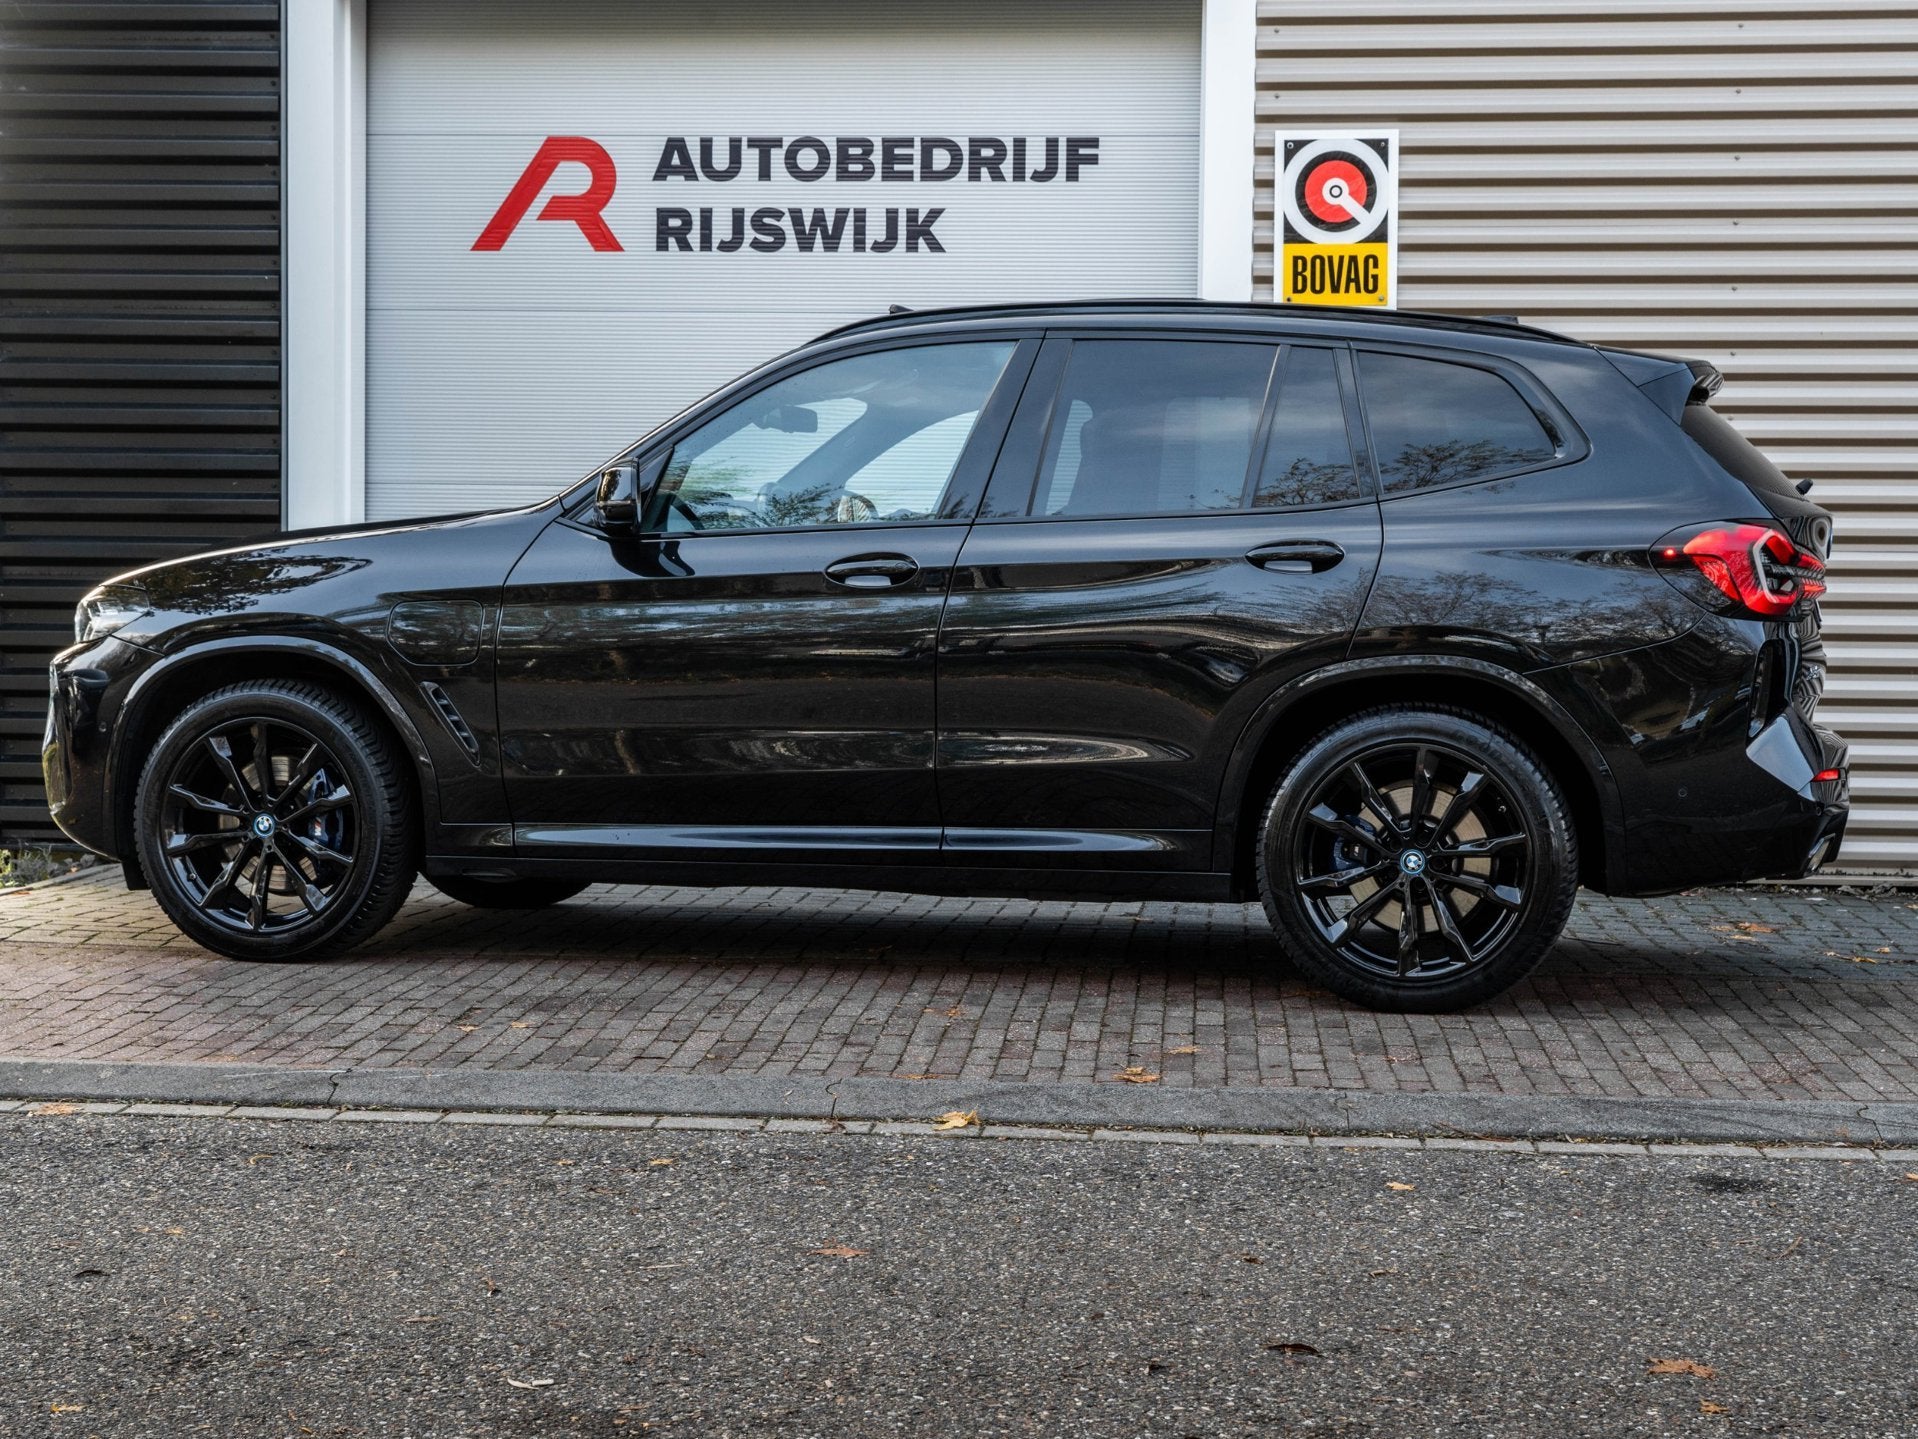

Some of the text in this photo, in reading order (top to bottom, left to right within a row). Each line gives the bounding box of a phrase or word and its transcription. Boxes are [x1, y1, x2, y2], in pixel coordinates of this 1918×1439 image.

[652, 136, 1100, 183] AUTOBEDRIJF
[655, 207, 946, 253] RIJSWIJK
[1292, 254, 1379, 295] BOVAG
